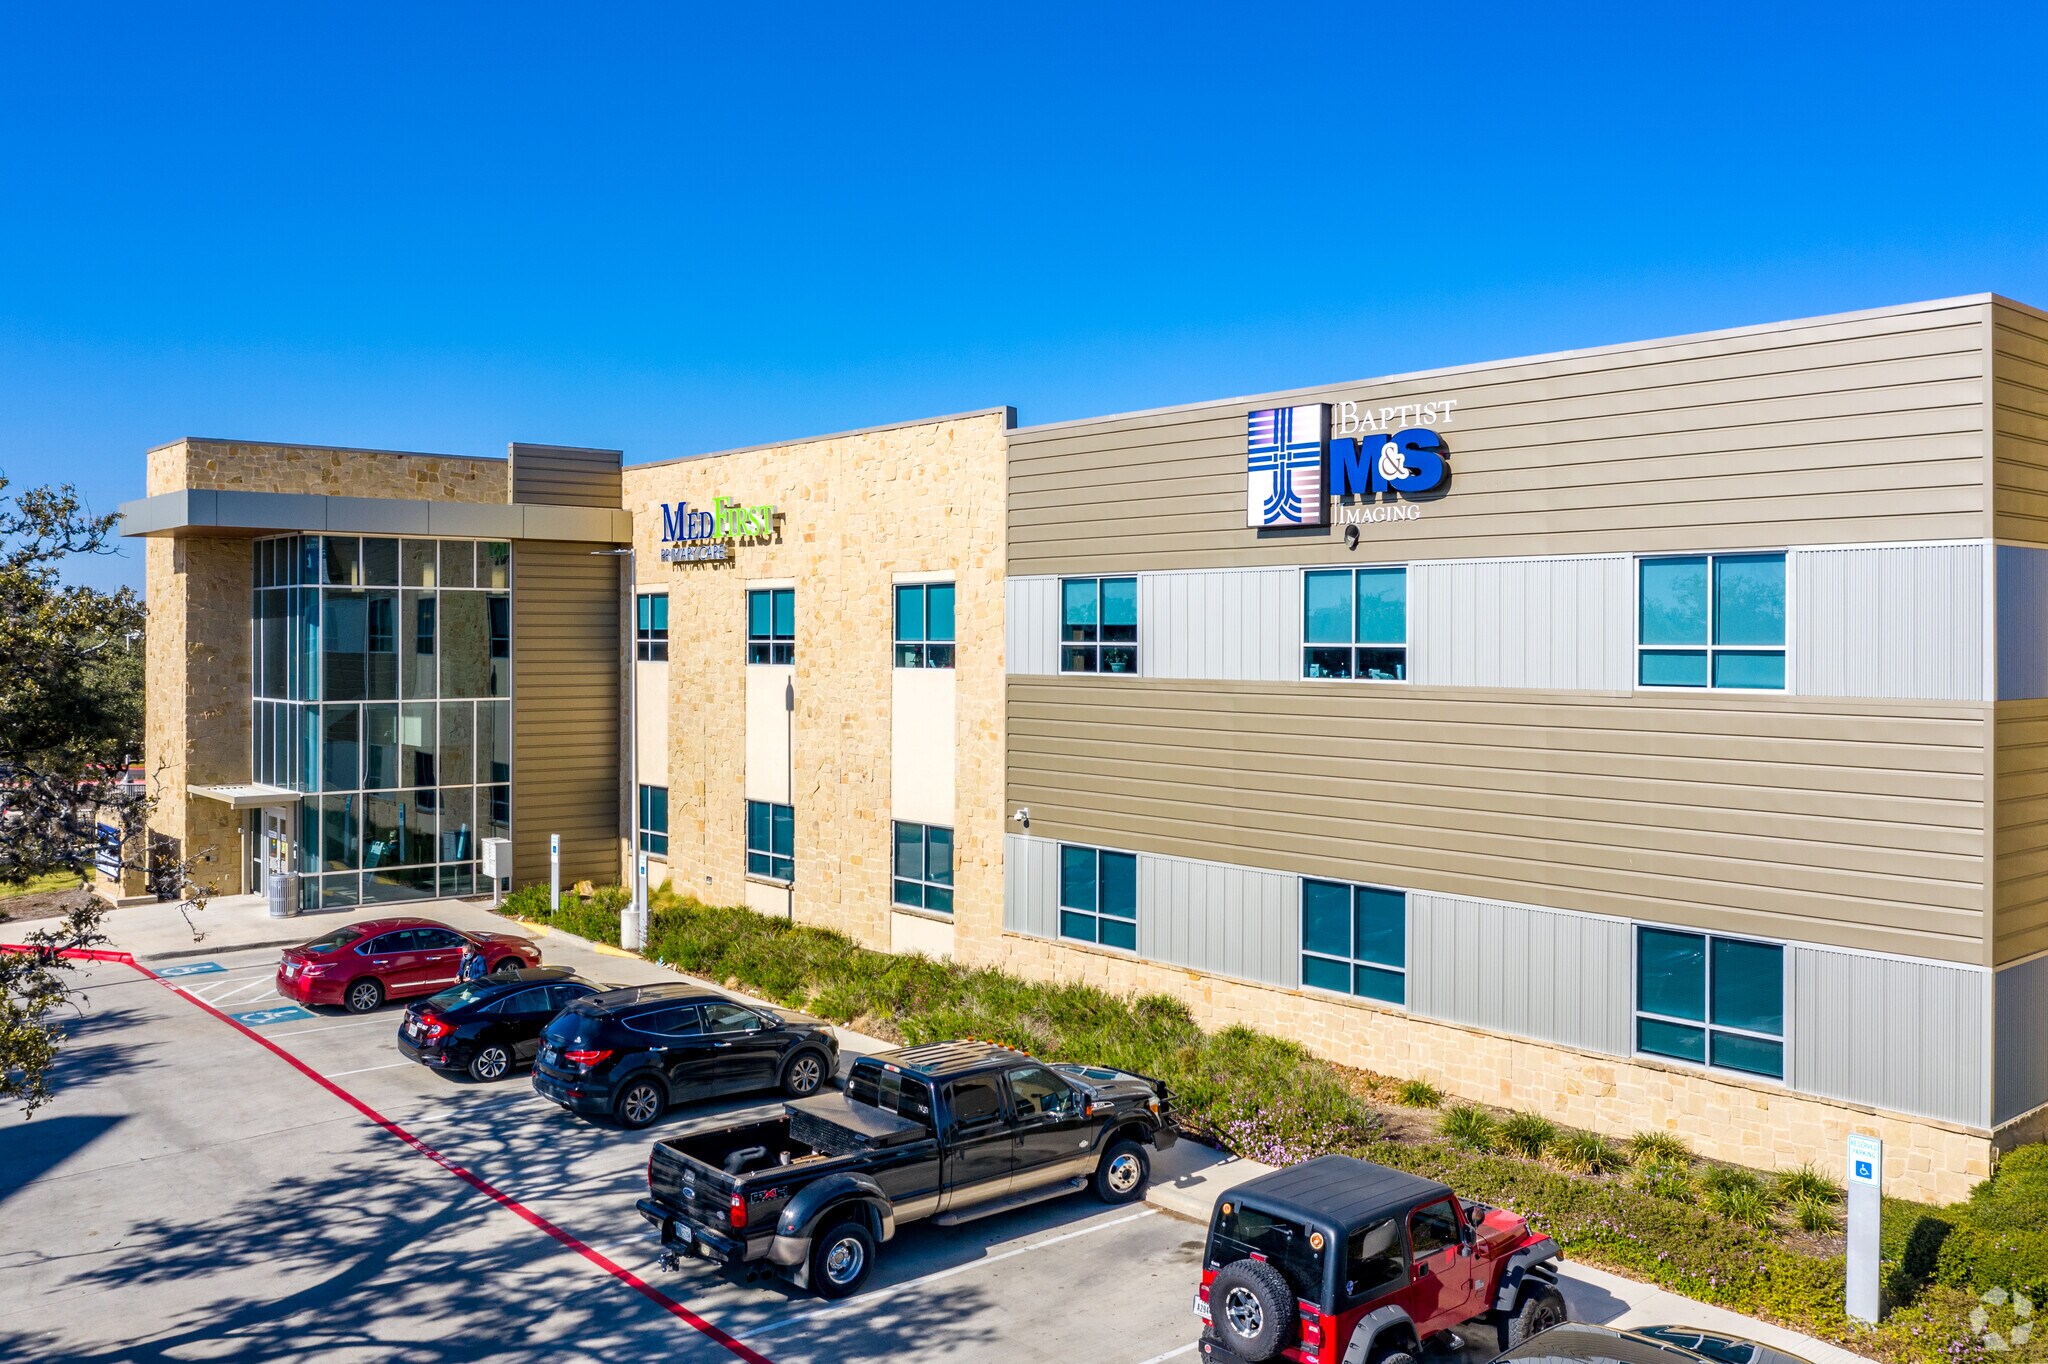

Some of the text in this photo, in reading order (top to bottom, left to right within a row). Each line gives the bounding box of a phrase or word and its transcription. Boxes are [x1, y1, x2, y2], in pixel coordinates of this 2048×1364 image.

[1339, 400, 1457, 435] BAPTIST
[1329, 428, 1444, 496] M&S
[661, 496, 774, 542] MEDFIRST
[1339, 503, 1421, 525] IMAGING
[660, 544, 726, 562] PRIMARY CARE
[1850, 1140, 1878, 1151] RESERVED
[1852, 1148, 1876, 1159] PARKING
